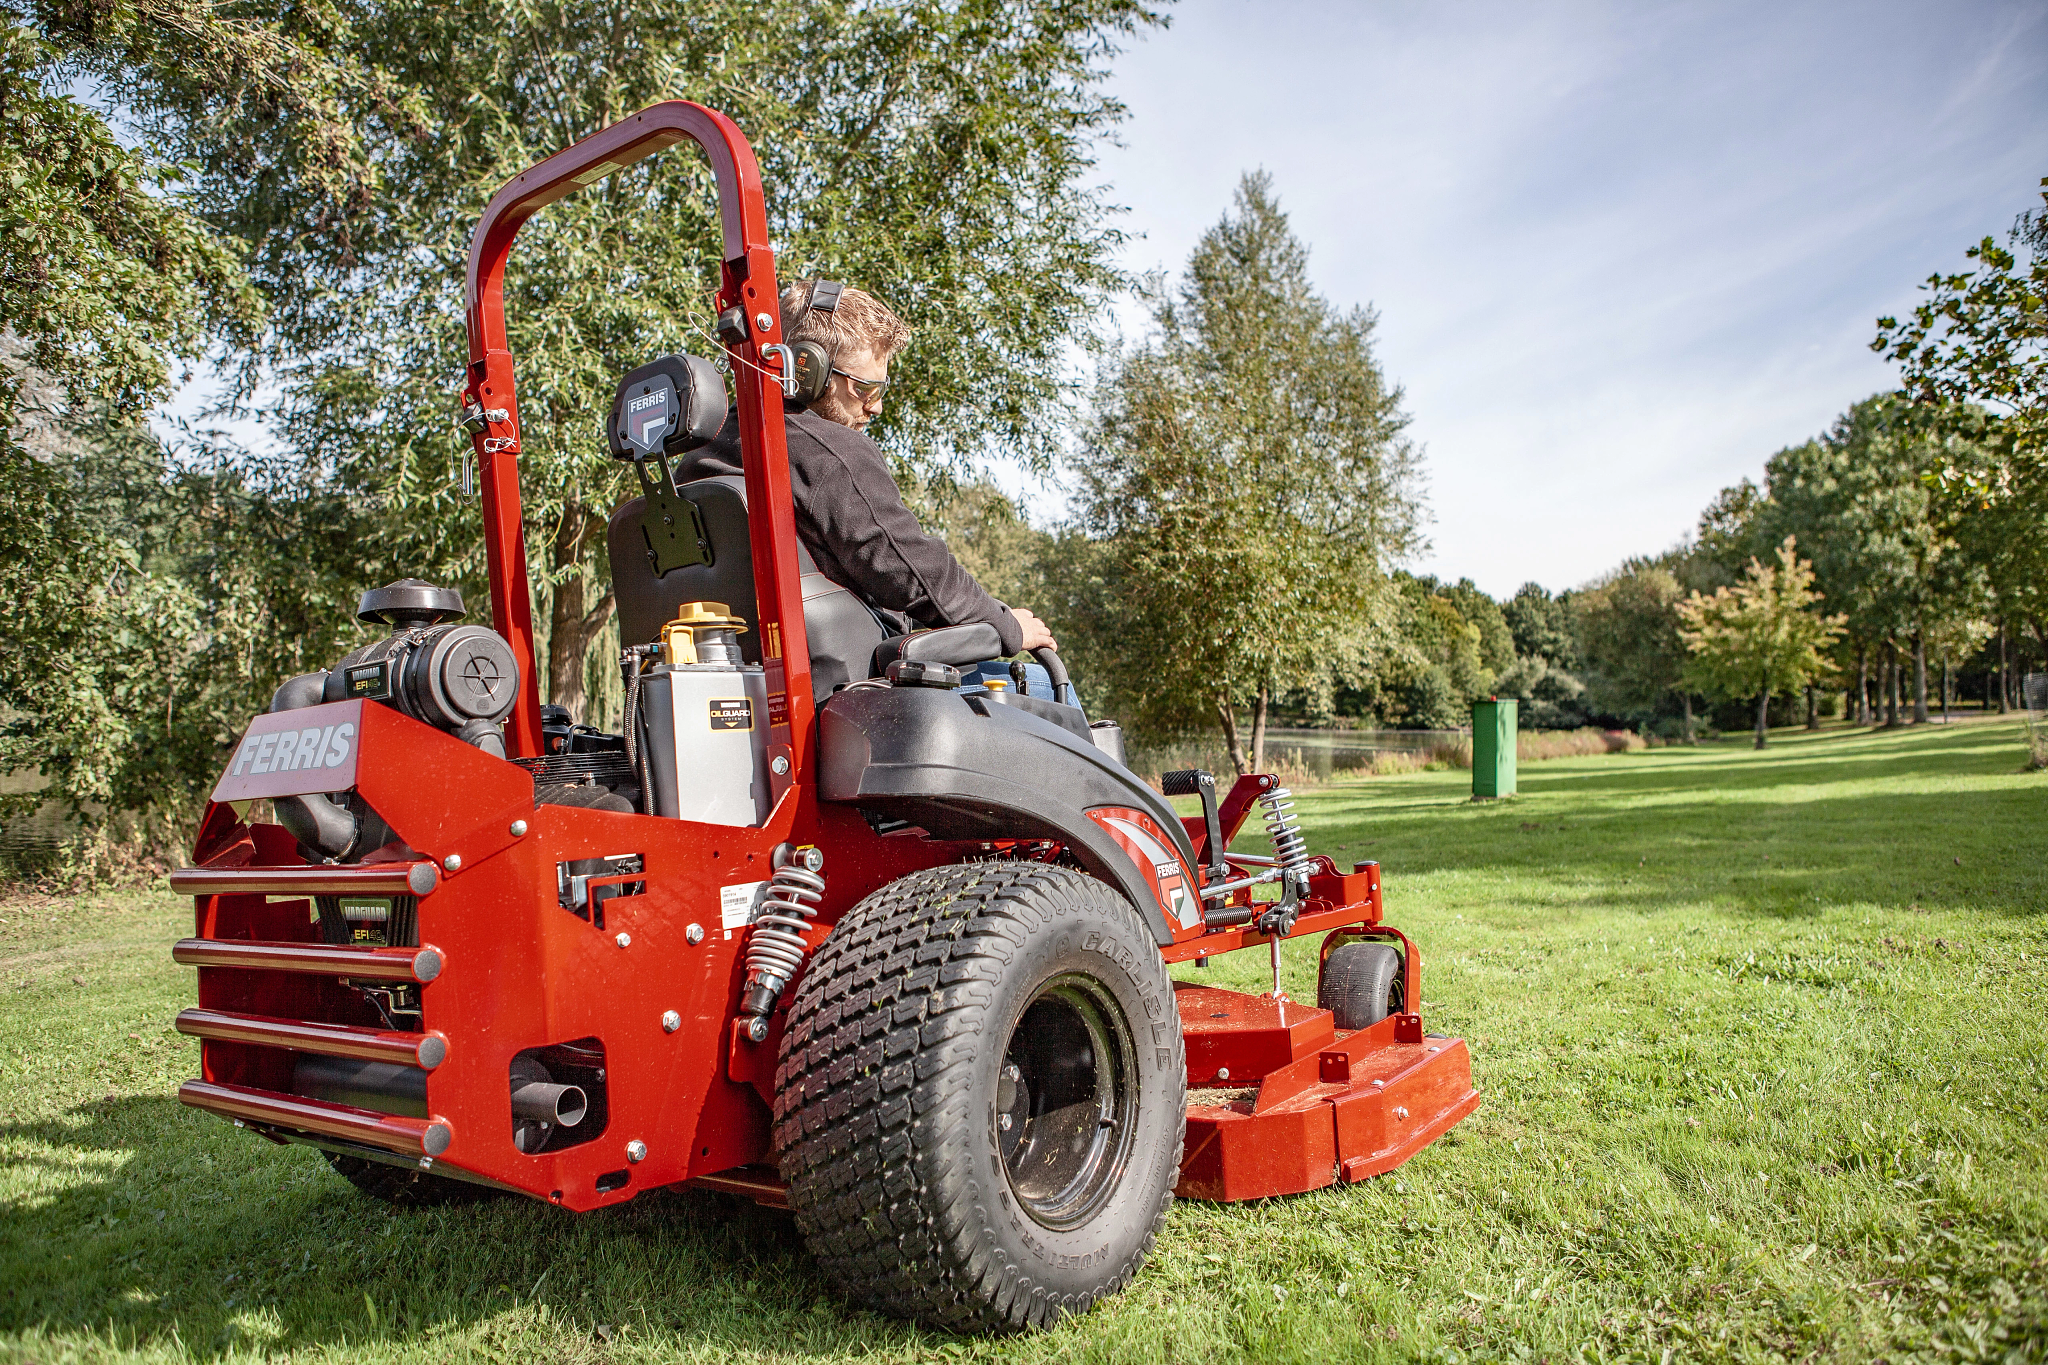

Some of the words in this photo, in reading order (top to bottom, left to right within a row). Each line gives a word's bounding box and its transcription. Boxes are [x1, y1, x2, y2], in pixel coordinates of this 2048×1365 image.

[630, 391, 666, 413] FERRIS
[232, 722, 355, 776] FERRIS
[1156, 862, 1180, 878] FERRIS
[344, 906, 387, 921] VANGUARD
[1081, 930, 1172, 1071] CARLISLE
[1049, 1242, 1110, 1270] MULTI
